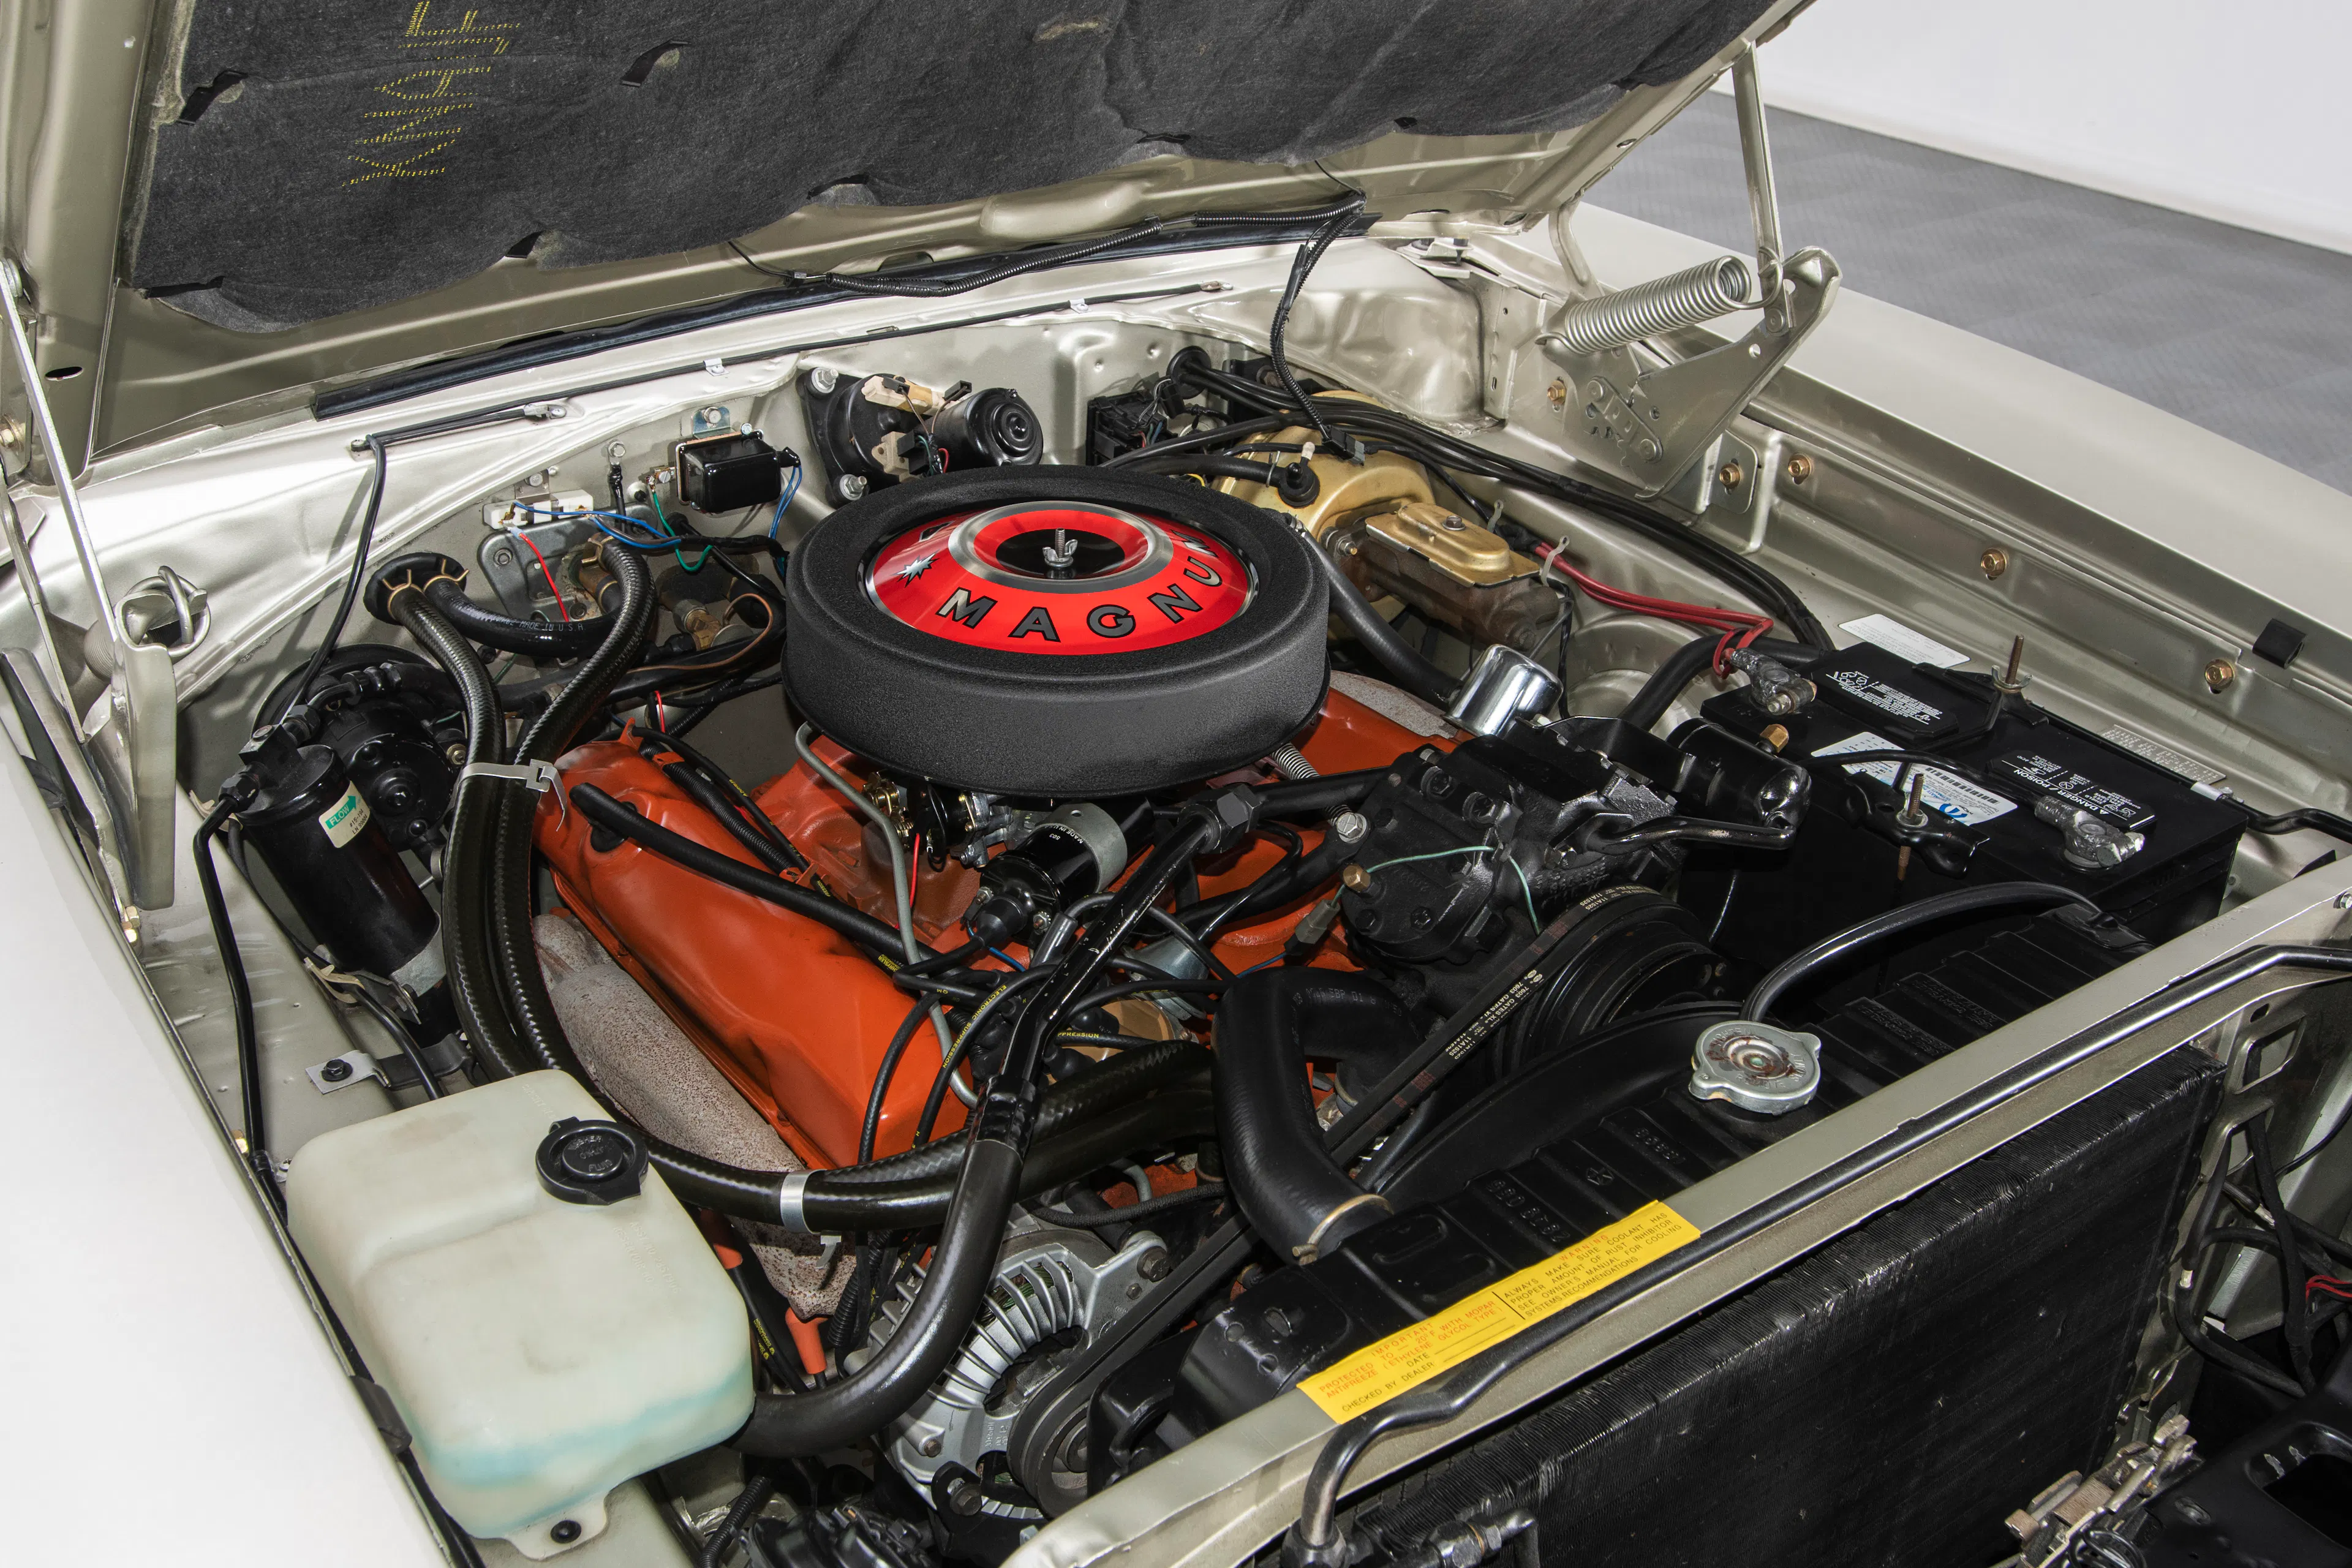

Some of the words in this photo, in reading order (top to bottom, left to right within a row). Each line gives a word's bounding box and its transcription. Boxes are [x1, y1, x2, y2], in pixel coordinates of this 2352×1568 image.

[938, 529, 1223, 643] MAGNUM
[2012, 769, 2051, 787] POISON
[329, 804, 350, 826] FLOW
[2056, 790, 2100, 810] DANGER
[1066, 829, 1084, 843] MADE
[972, 985, 1007, 1020] ELECTRONIC
[1509, 981, 1523, 994] 7603
[1515, 985, 1529, 998] 7603
[1494, 997, 1515, 1017] GATES
[943, 1023, 971, 1068] SUPPRESSION
[1449, 1035, 1472, 1057] 11A1525
[1504, 1277, 1539, 1299] ALWAYS
[1545, 1261, 1570, 1278] MAKE
[1577, 1245, 1600, 1262] SURE
[1607, 1224, 1644, 1246] COOLANT
[1650, 1212, 1667, 1224] HAS
[1511, 1283, 1546, 1306] PROPER
[1551, 1263, 1585, 1284] AMOUNT
[1591, 1254, 1602, 1264] OF
[1605, 1242, 1627, 1256] RUST
[1632, 1218, 1673, 1242] INHIBITOR
[1559, 1234, 1608, 1262] WARNING
[1519, 1298, 1537, 1311] SEE
[1542, 1275, 1581, 1300] OWNER'S
[1586, 1254, 1620, 1276] MANUAL
[1624, 1243, 1642, 1256] FOR
[1645, 1223, 1682, 1246] COOLING
[1319, 1362, 1373, 1393] PROTECTED
[1381, 1351, 1394, 1362] TO
[1439, 1316, 1463, 1333] WITH
[1465, 1300, 1495, 1319] MOPAR
[1371, 1321, 1433, 1358] IMPORTANT
[1326, 1368, 1378, 1399] ANTIFREEZE
[1438, 1321, 1471, 1342] GLYCOL
[1406, 1351, 1430, 1368] DATE
[1342, 1387, 1383, 1414] CHECKED
[1385, 1380, 1398, 1390] BY
